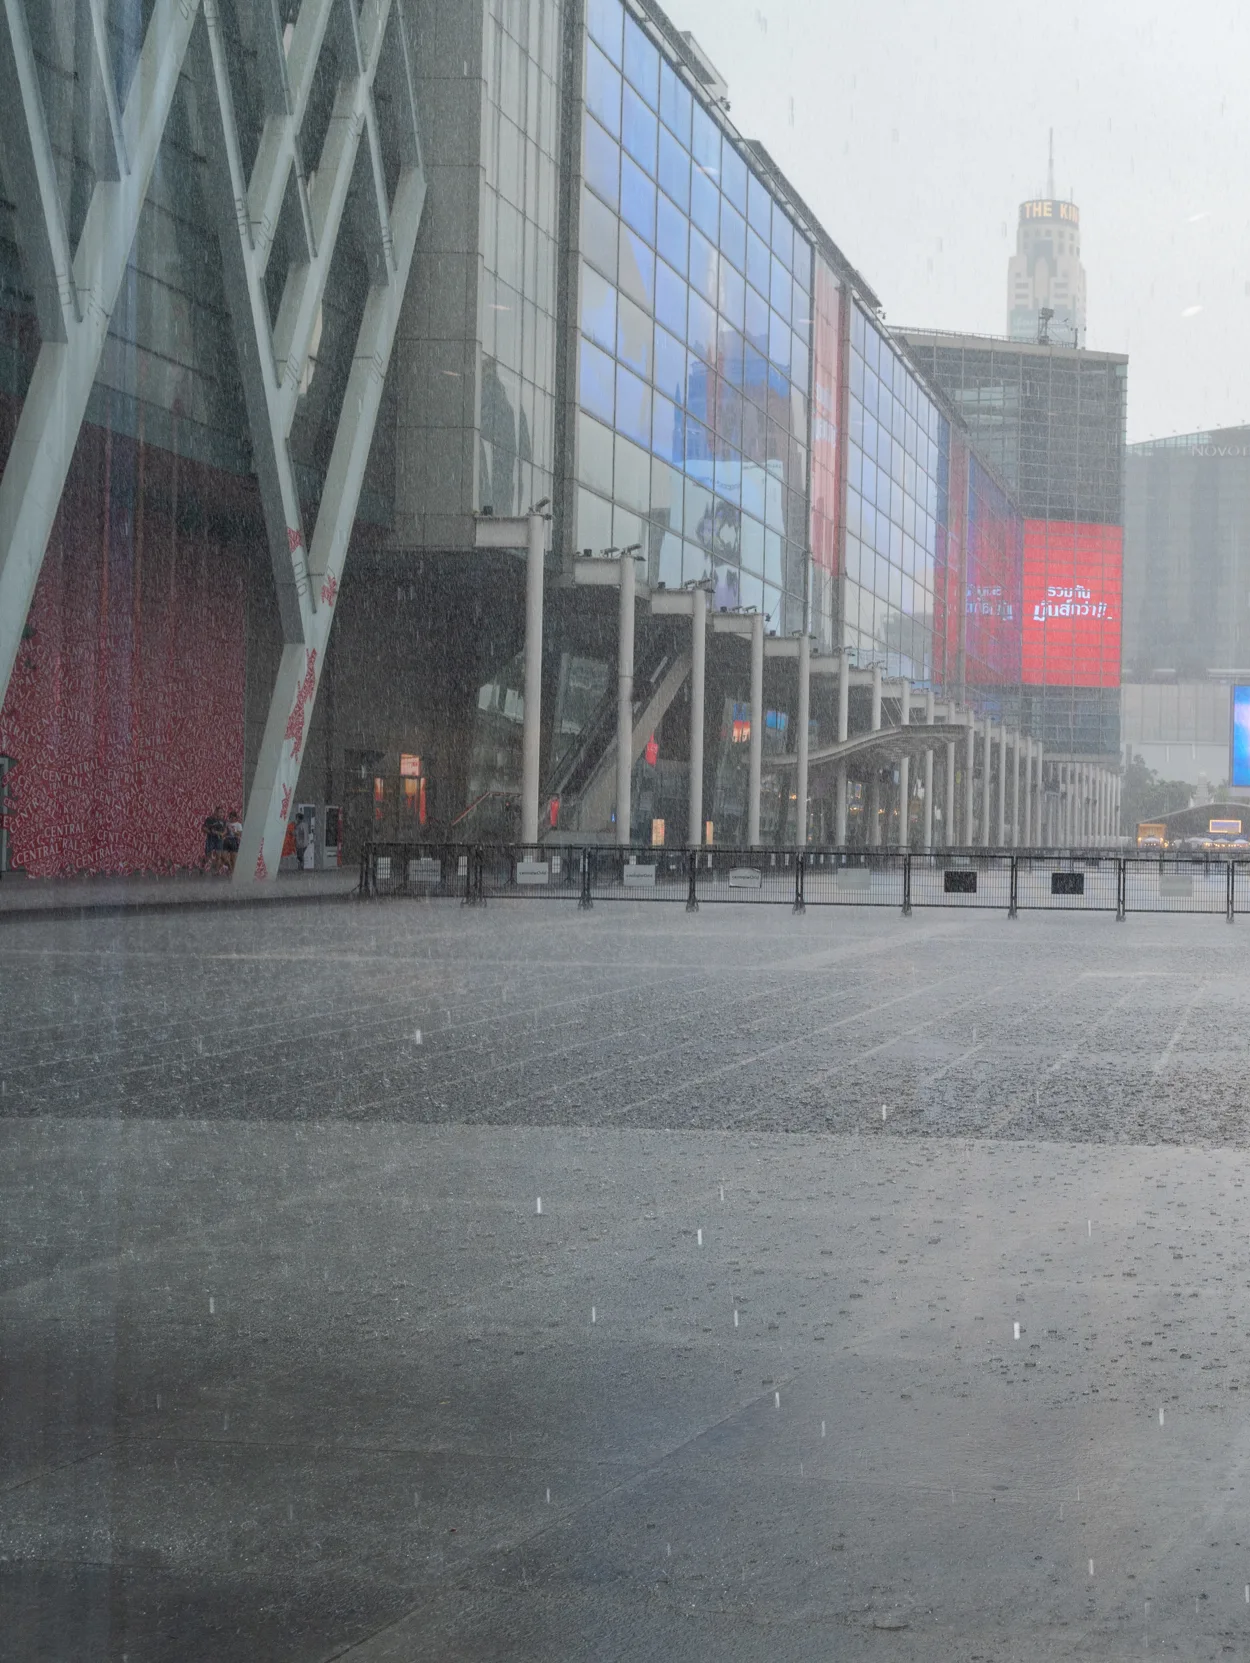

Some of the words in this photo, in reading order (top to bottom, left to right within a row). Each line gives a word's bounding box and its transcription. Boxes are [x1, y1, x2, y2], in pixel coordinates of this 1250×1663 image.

[1024, 201, 1052, 218] THE
[44, 822, 86, 837] CENTRAL
[16, 842, 61, 864] CENTRAL
[76, 844, 115, 868] CENTRAL
